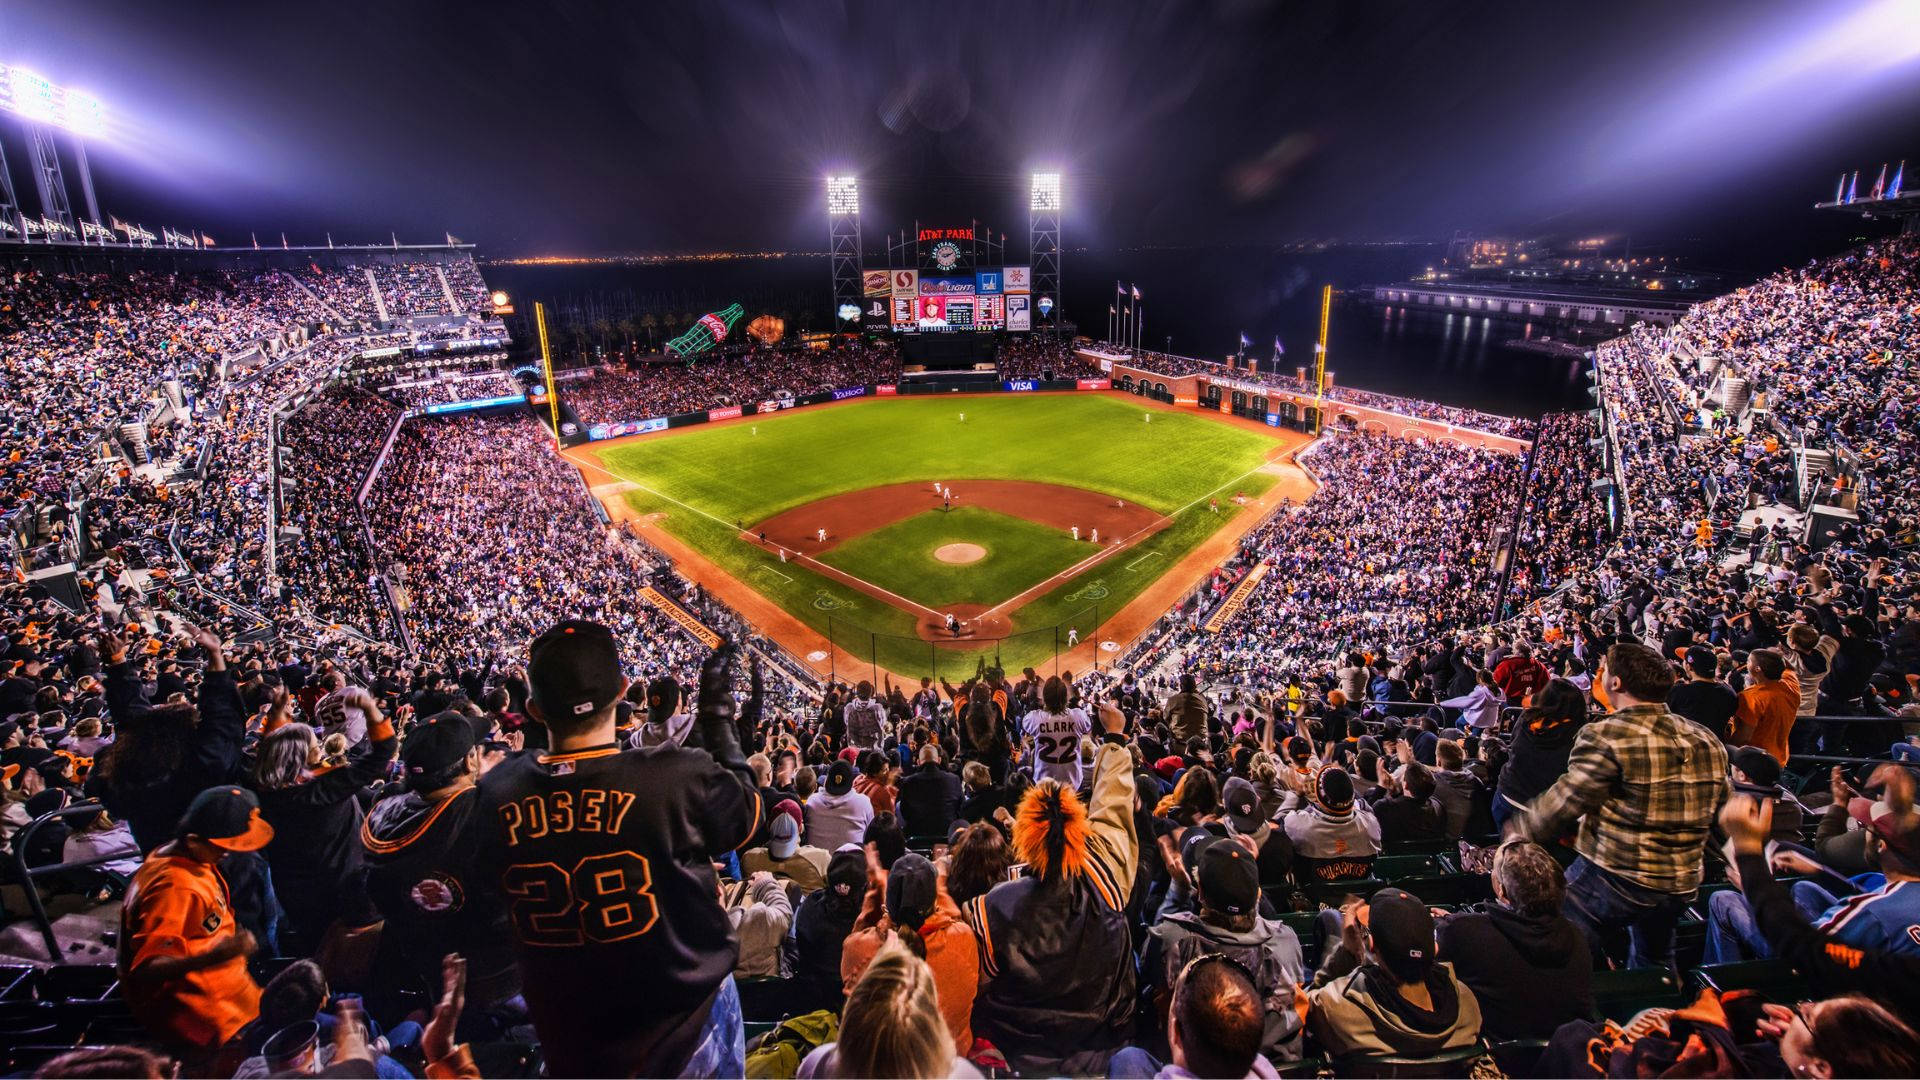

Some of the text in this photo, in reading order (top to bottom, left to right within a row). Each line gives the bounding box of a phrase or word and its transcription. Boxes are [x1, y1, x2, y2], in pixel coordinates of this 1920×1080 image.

[919, 228, 973, 241] AT&T PARK
[937, 263, 957, 271] GIANTS
[833, 387, 865, 399] YAHOO!
[1010, 382, 1033, 391] VISA
[1231, 381, 1267, 396] LANDING
[719, 409, 742, 418] TOYOTA
[686, 621, 711, 639] GIANTS
[321, 702, 346, 726] 55
[1040, 721, 1075, 733] CLARK
[1037, 735, 1077, 765] 22
[498, 788, 636, 847] POSEY
[502, 850, 660, 946] 28
